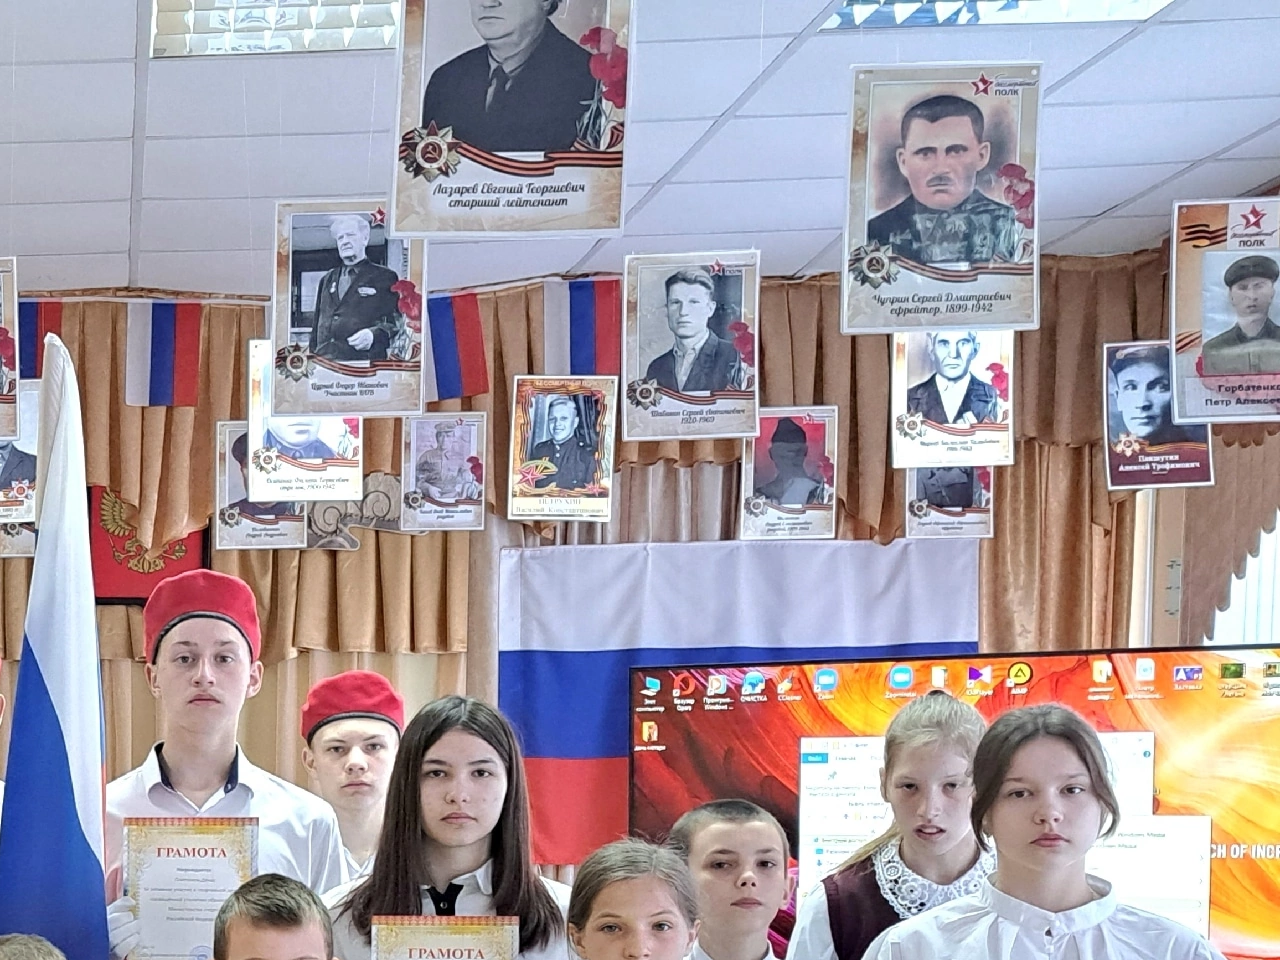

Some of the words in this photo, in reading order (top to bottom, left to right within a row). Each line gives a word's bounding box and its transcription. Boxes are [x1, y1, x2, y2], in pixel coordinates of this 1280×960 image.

[433, 183, 479, 197] Лазарев
[481, 182, 523, 194] Евгений
[525, 182, 585, 197] Георгиевич
[449, 198, 500, 210] старший
[502, 198, 568, 208] лейтенант
[1238, 240, 1266, 248] ПОЛК
[872, 294, 910, 306] Чуприн
[911, 293, 942, 304] Сергей
[945, 302, 993, 314] 1899-1942
[1206, 398, 1232, 406] Петр
[156, 847, 228, 858] ГРАМОТА
[1230, 844, 1248, 859] OF
[407, 948, 486, 960] ГРАМОТА
